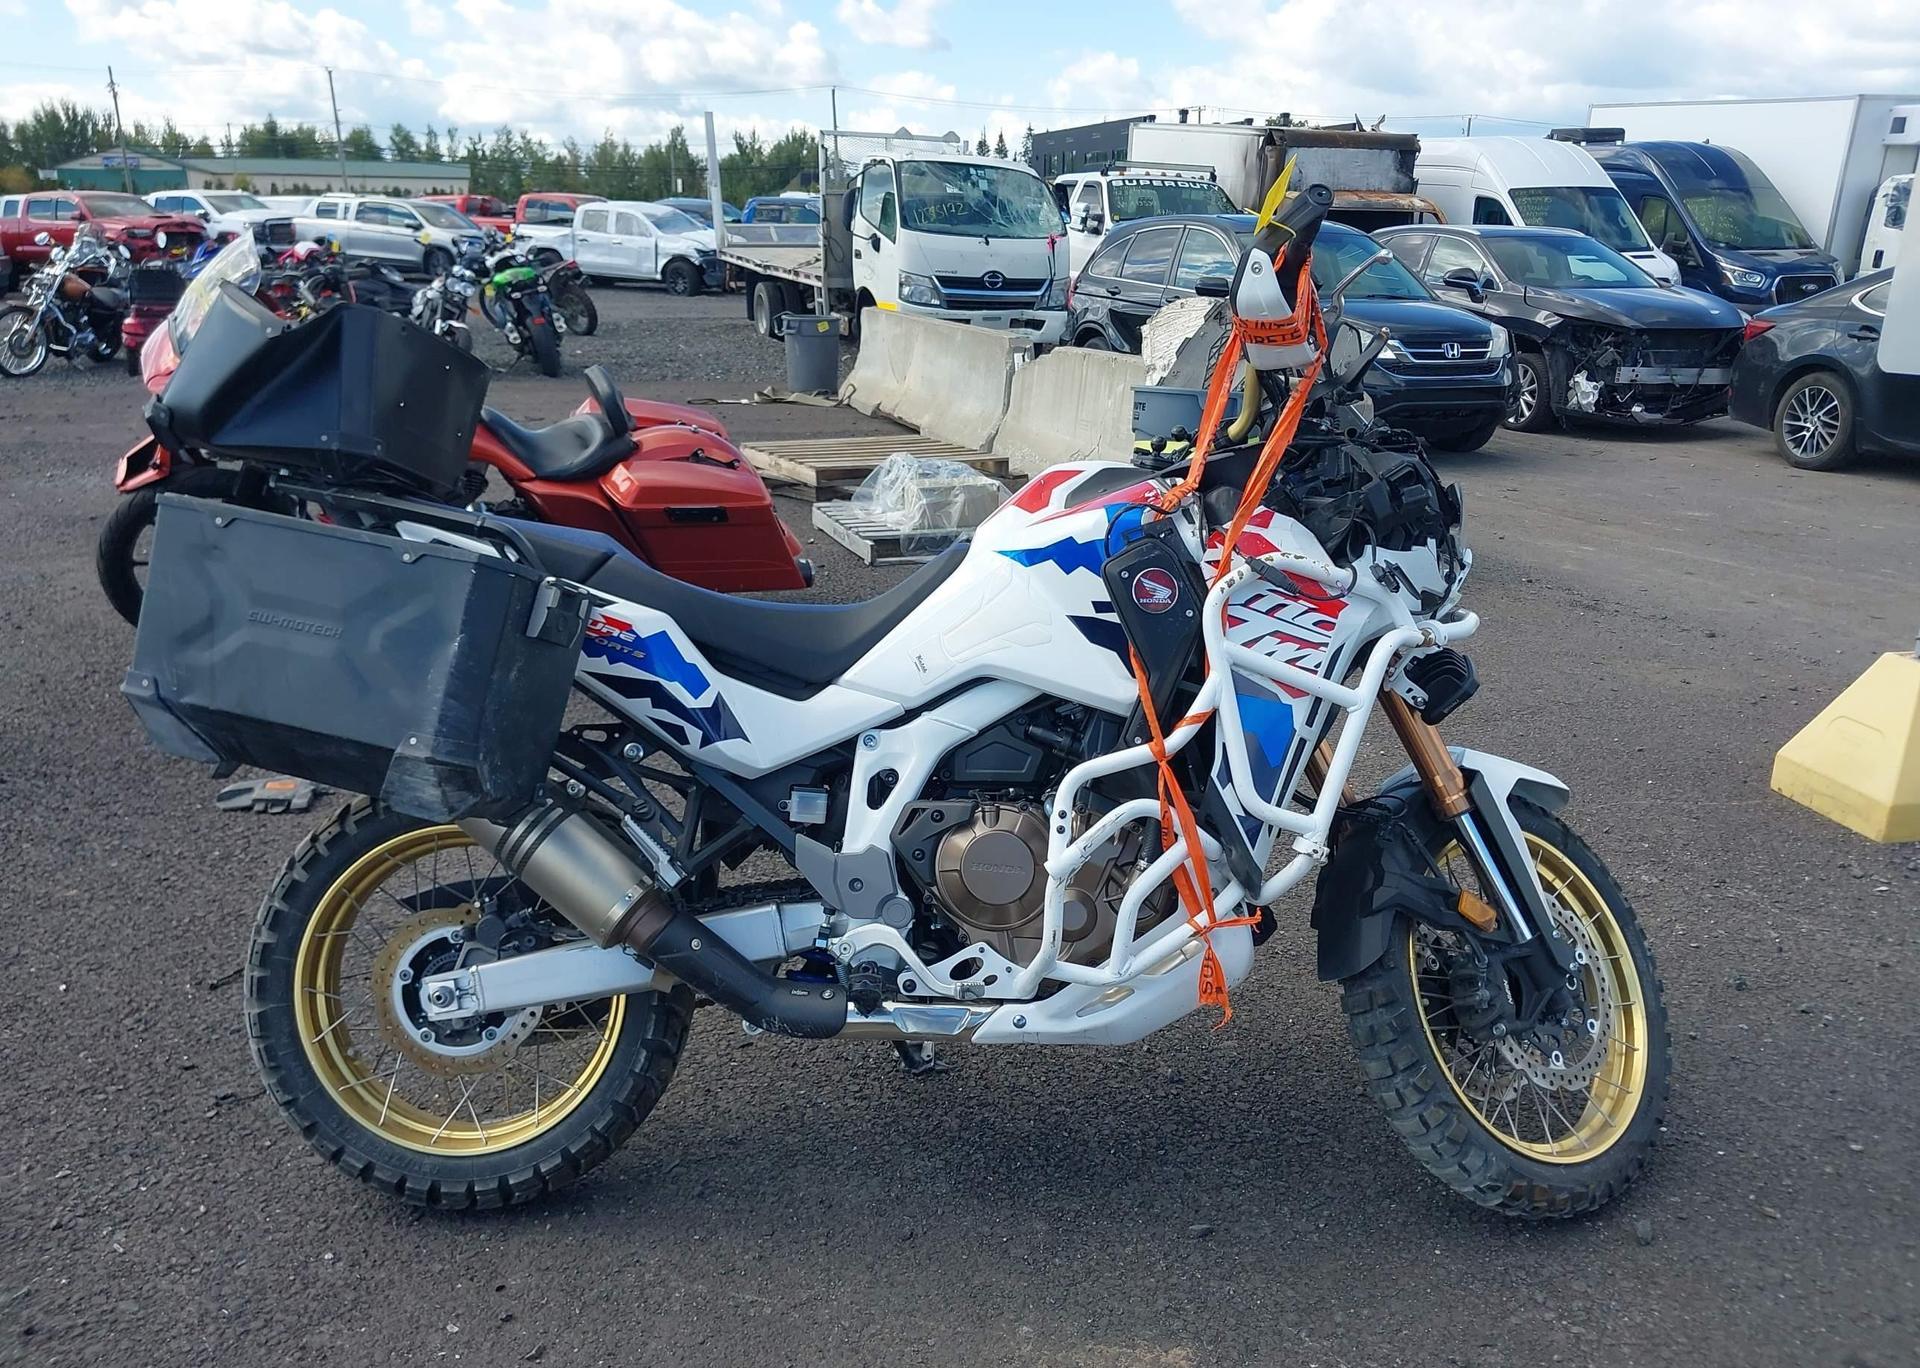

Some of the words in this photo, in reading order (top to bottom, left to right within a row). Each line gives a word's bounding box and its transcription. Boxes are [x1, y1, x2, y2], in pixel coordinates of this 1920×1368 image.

[247, 610, 344, 640] SW-MOTECH
[586, 619, 637, 643] URE
[594, 637, 647, 659] ORTS
[970, 862, 1027, 875] HONDA
